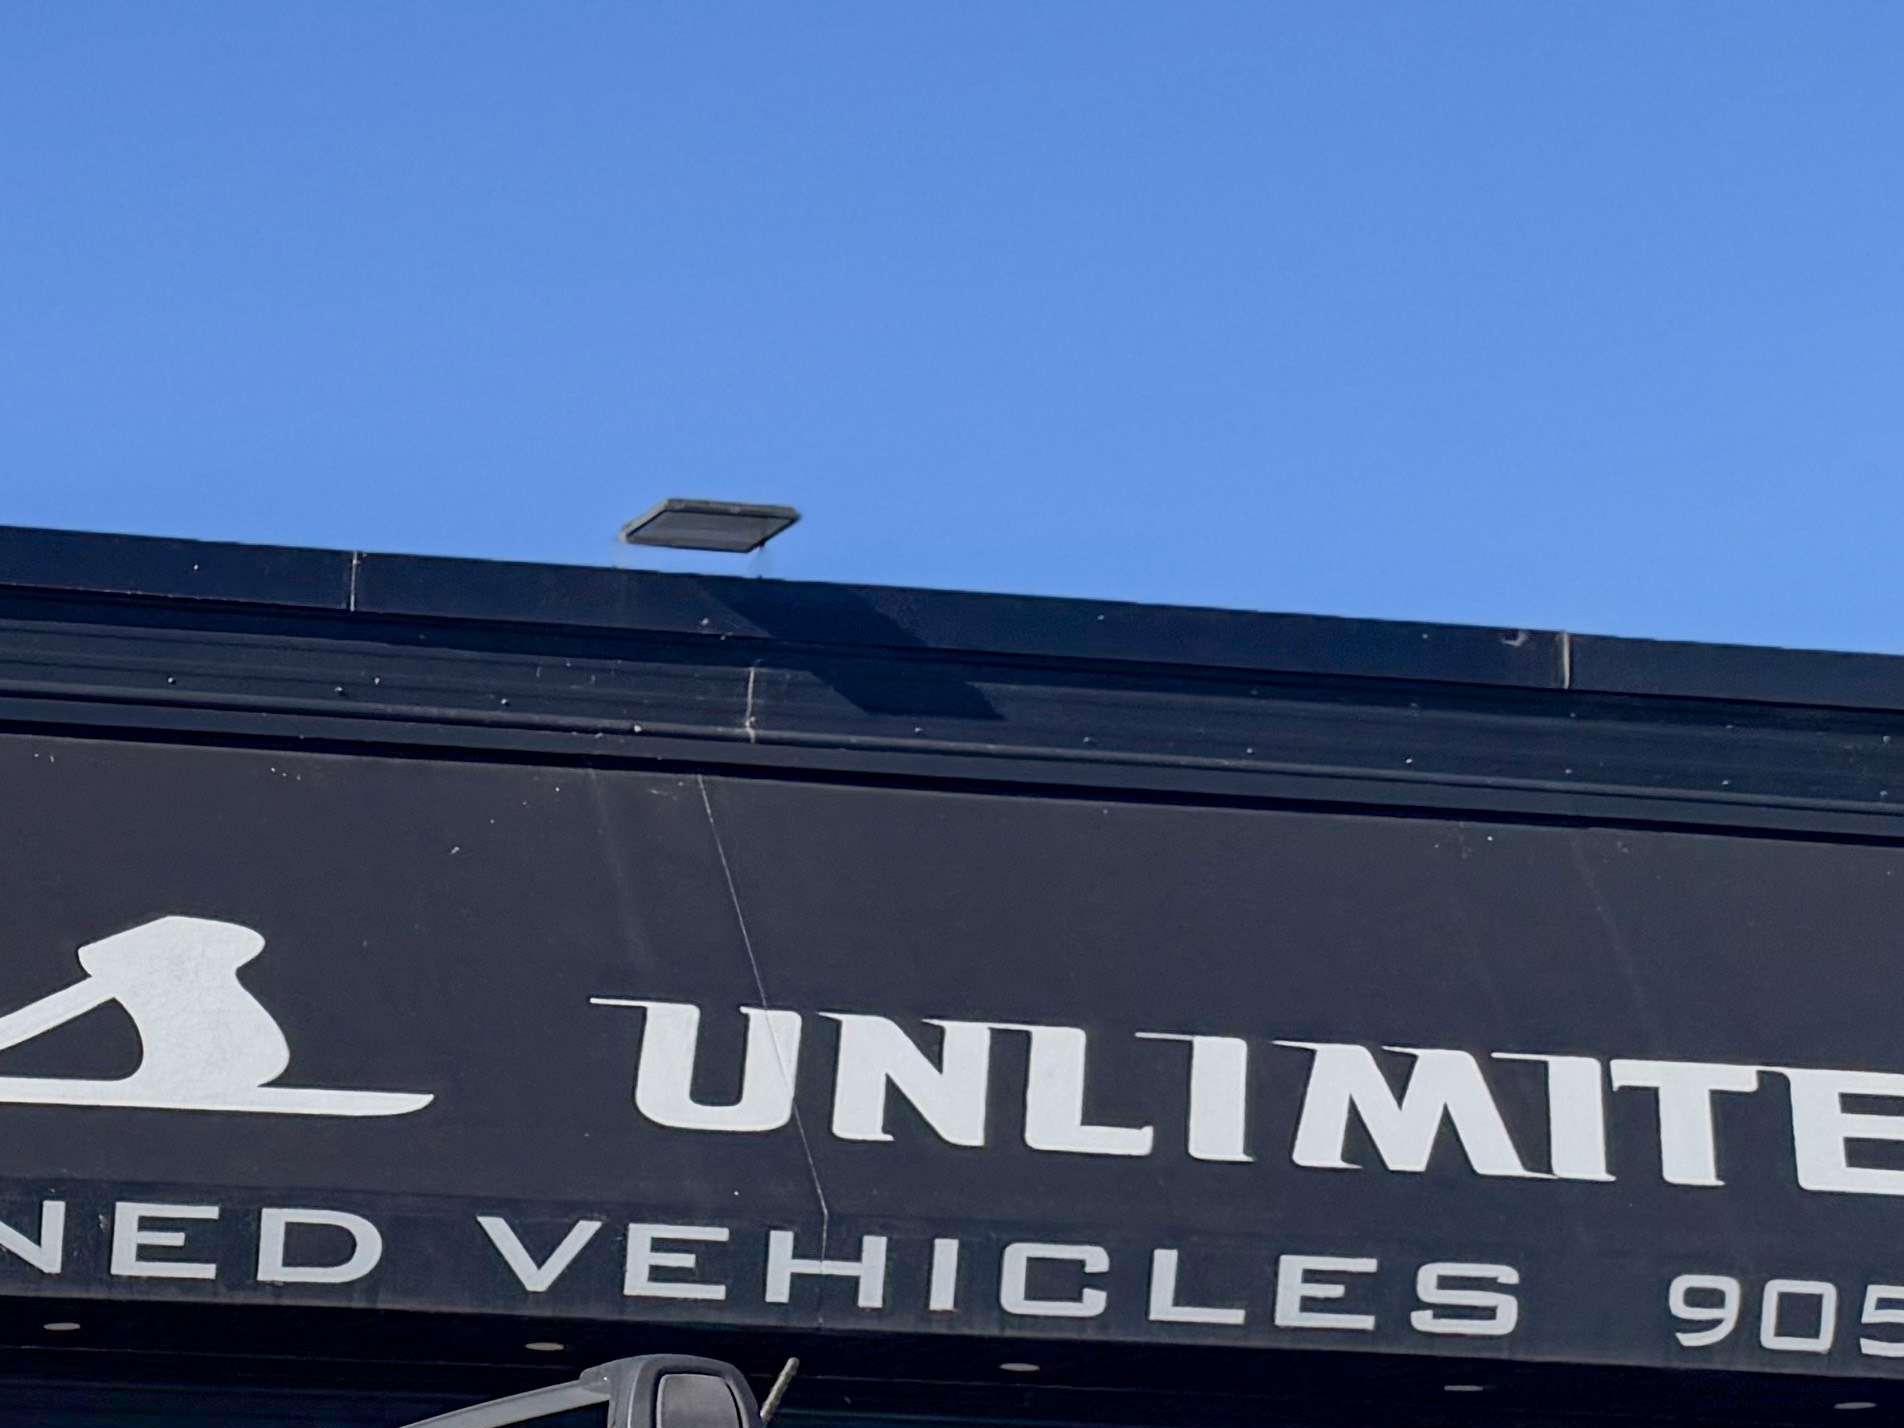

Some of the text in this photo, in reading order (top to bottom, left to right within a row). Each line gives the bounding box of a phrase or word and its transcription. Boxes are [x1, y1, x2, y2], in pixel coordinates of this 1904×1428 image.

[588, 996, 1904, 1196] UNLIMITE
[475, 1215, 1521, 1337] VEHICLES
[1667, 1273, 1904, 1358] 905
